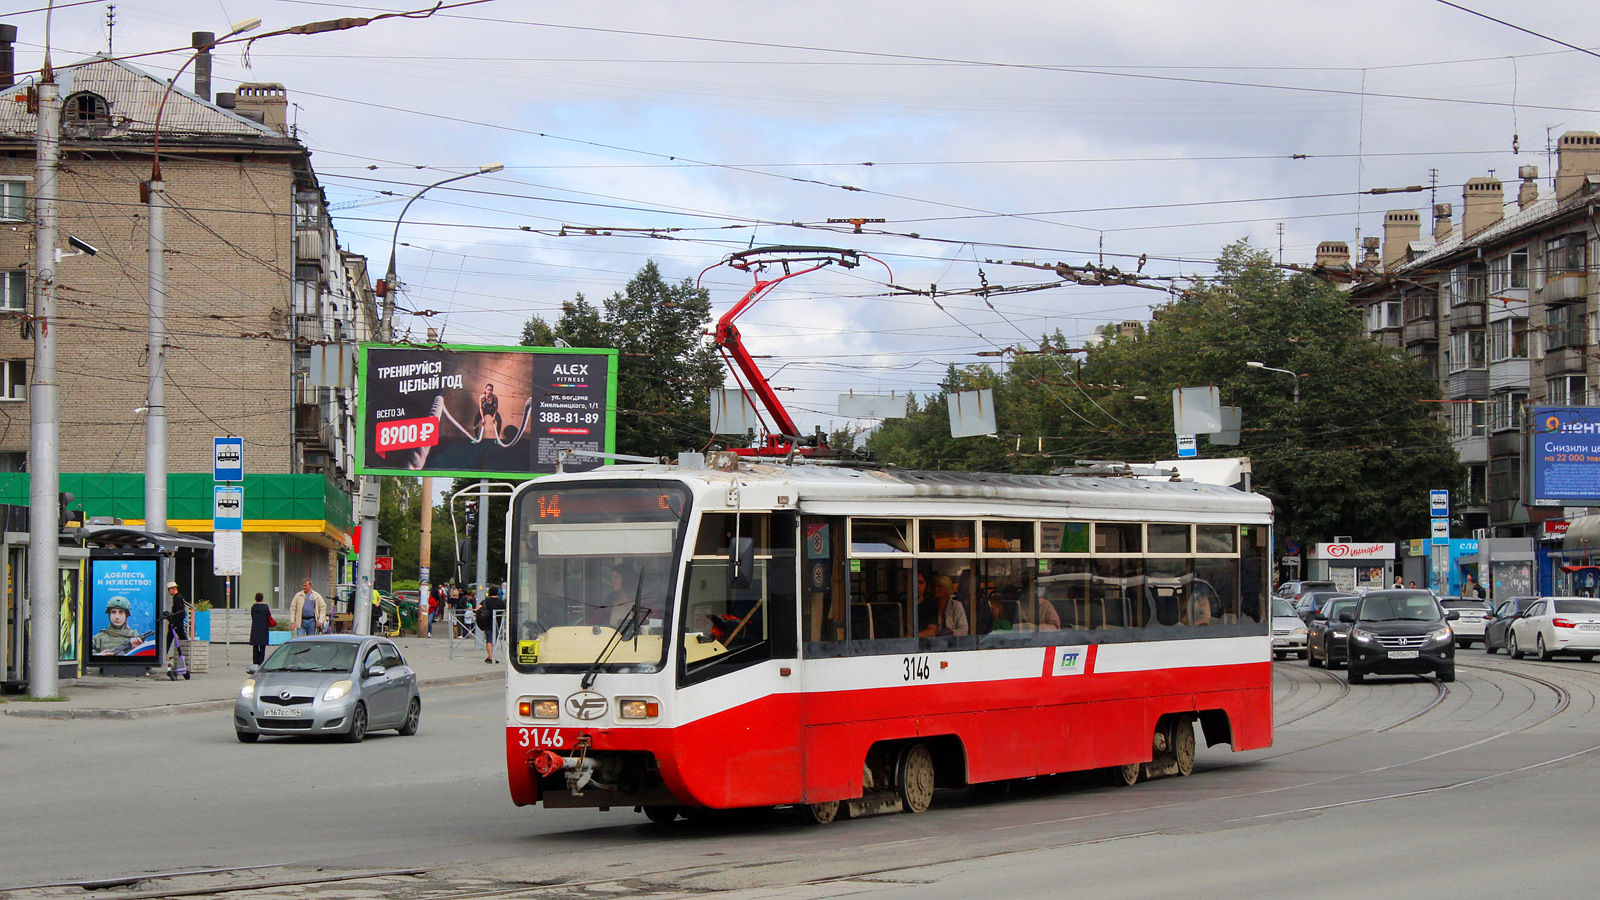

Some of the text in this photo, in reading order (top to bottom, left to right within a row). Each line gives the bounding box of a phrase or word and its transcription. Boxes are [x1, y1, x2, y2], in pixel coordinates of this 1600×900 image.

[378, 361, 442, 379] ТРЕНИРУЙСЯ
[552, 363, 589, 376] ALEX
[399, 374, 463, 395] ЦЕЛЫЙ ГОД
[376, 408, 406, 419] ВСЕГО ЗА
[539, 412, 600, 424] 388-81-89
[380, 424, 418, 446] 8900
[1545, 441, 1588, 453] Снизили
[1556, 454, 1567, 462] 22
[1568, 454, 1585, 462] 000
[537, 494, 561, 518] 14
[903, 656, 930, 681] 3146
[518, 727, 564, 748] 3146
